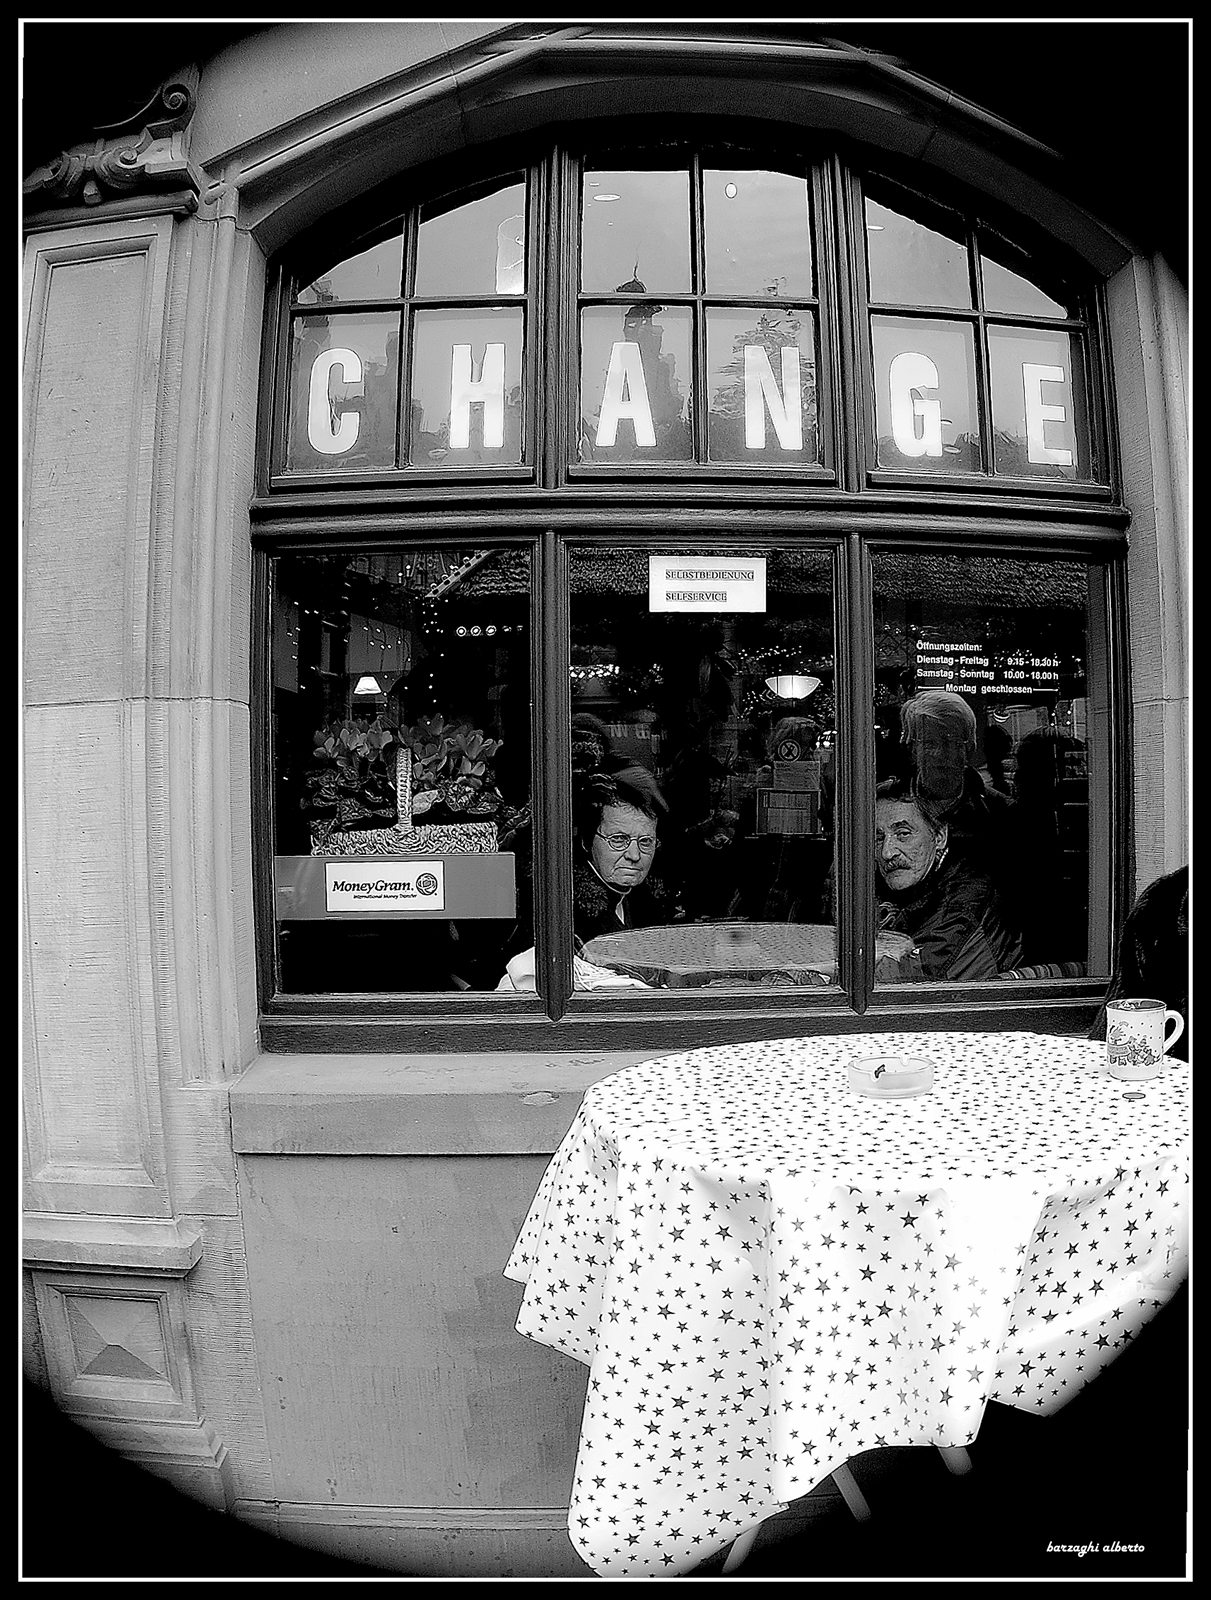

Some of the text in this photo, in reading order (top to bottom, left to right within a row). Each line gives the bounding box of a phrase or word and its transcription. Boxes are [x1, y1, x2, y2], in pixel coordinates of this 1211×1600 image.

[307, 343, 1074, 466] CHANGE
[665, 570, 754, 580] SELBSTBEDIENUNG
[665, 591, 727, 602] SELFSERVICE
[916, 640, 982, 652] Öffnungszeiten:
[945, 684, 1032, 694] Montag geschlossen
